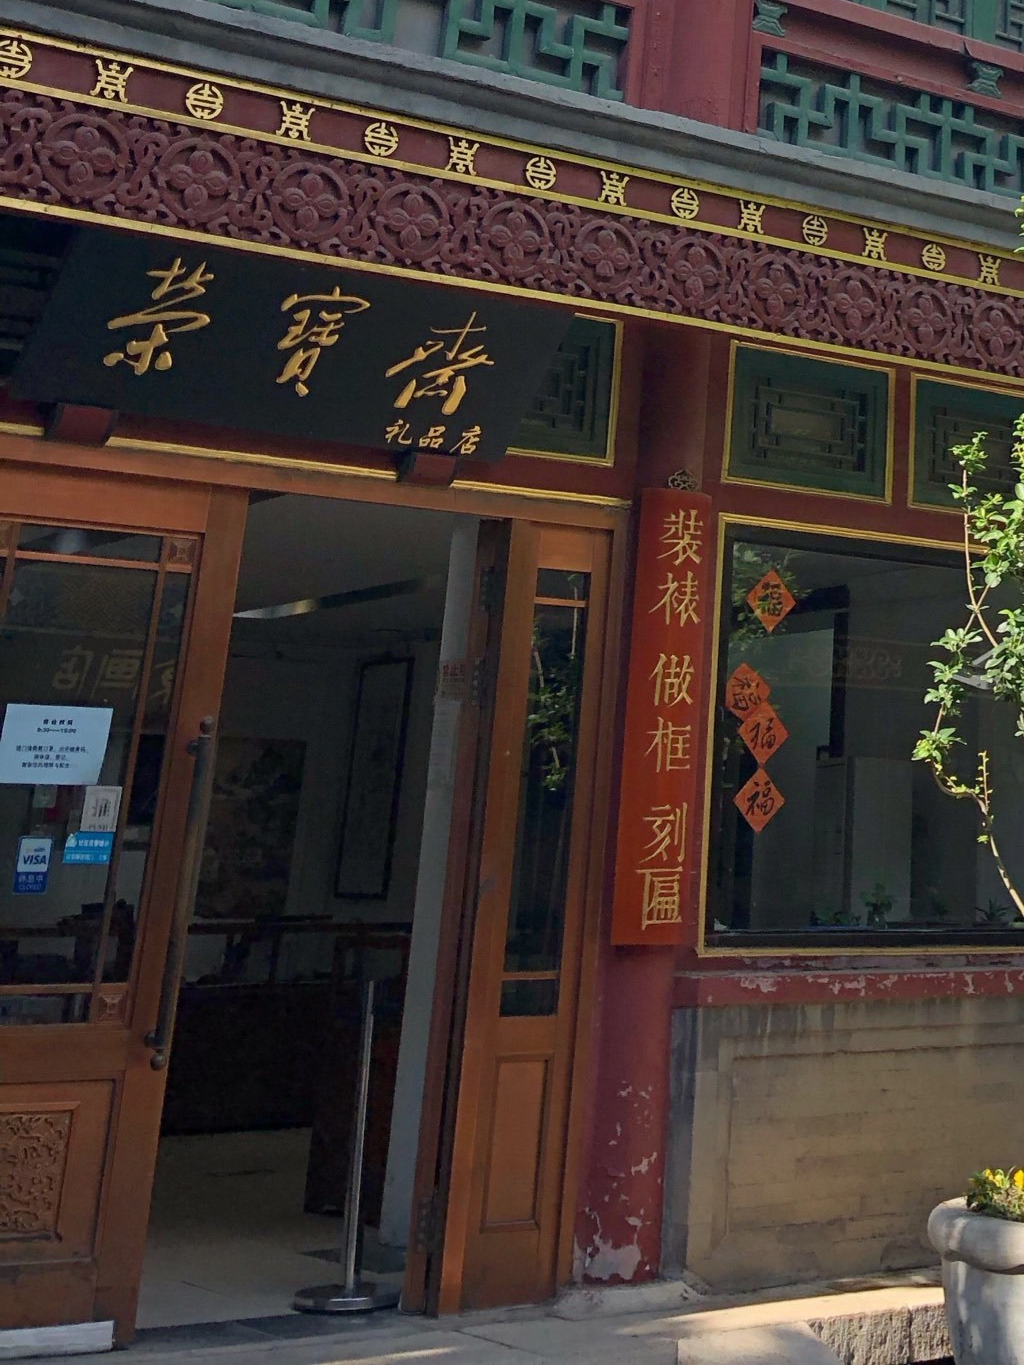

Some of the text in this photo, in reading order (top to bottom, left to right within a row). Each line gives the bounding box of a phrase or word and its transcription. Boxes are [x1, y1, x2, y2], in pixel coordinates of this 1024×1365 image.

[385, 419, 482, 455] 礼品店
[745, 780, 775, 816] 福
[23, 855, 47, 865] VISA
